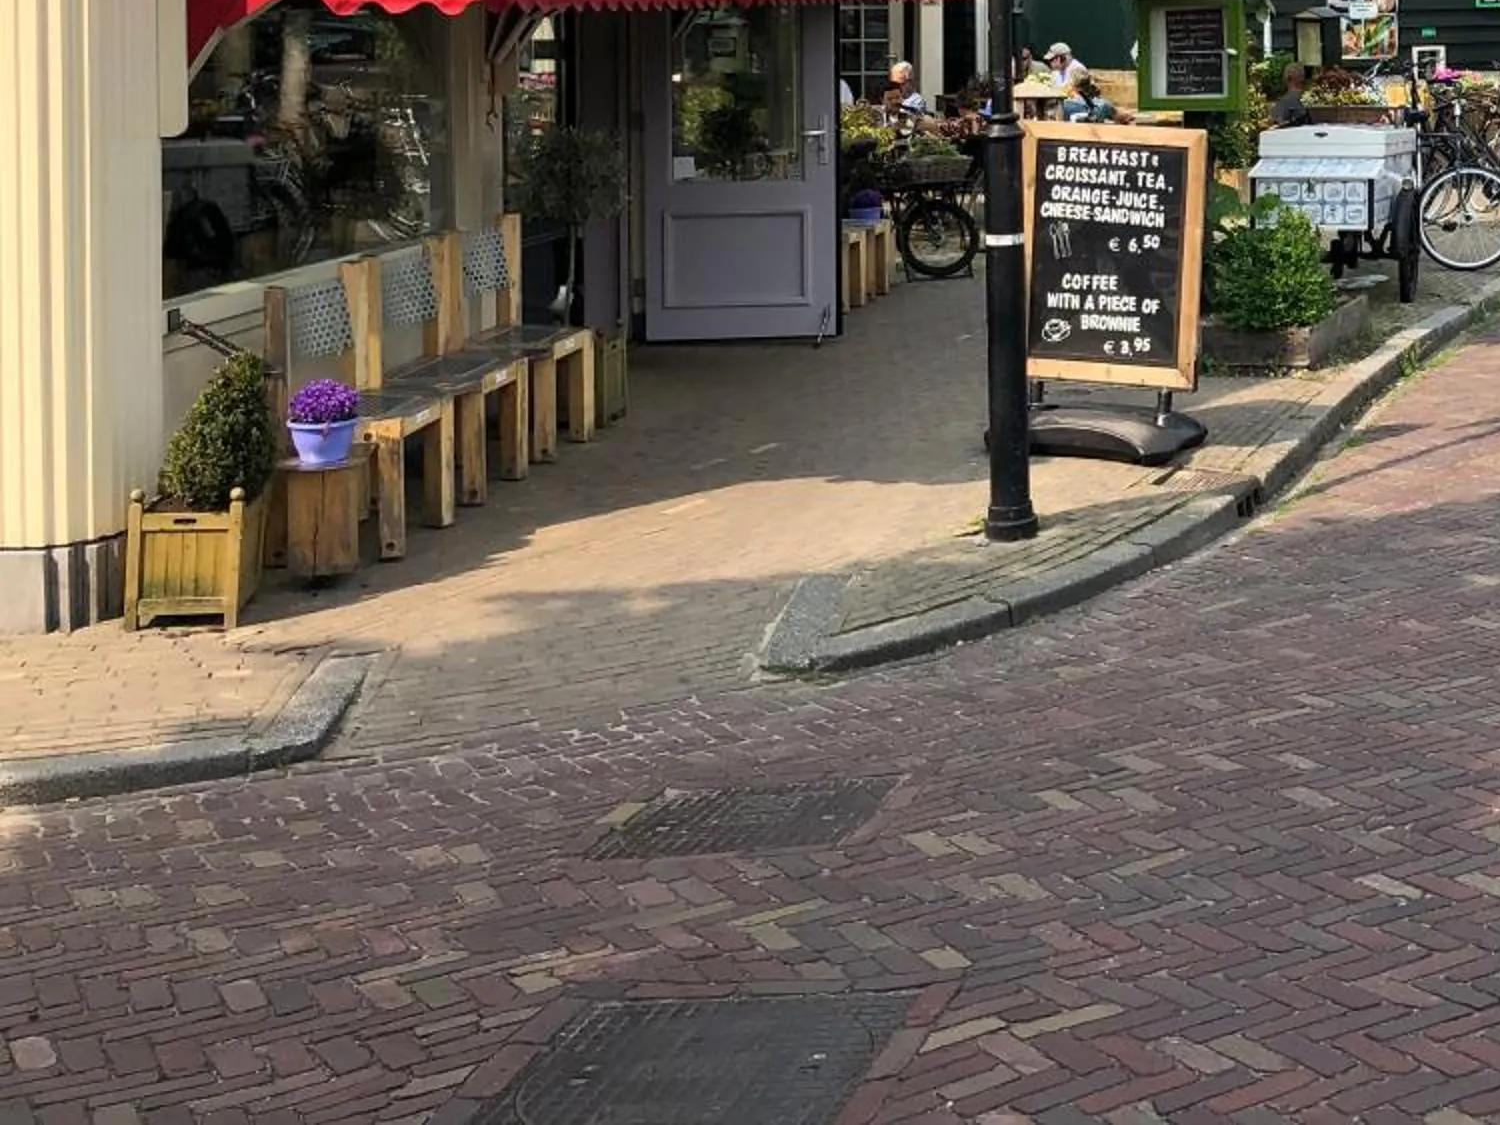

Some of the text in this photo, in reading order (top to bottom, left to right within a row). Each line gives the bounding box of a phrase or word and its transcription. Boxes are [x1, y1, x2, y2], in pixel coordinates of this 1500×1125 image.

[1062, 273, 1118, 290] COFFEE
[1047, 292, 1160, 313] WITH A PIECE OF
[1080, 315, 1141, 332] BROWNIE
